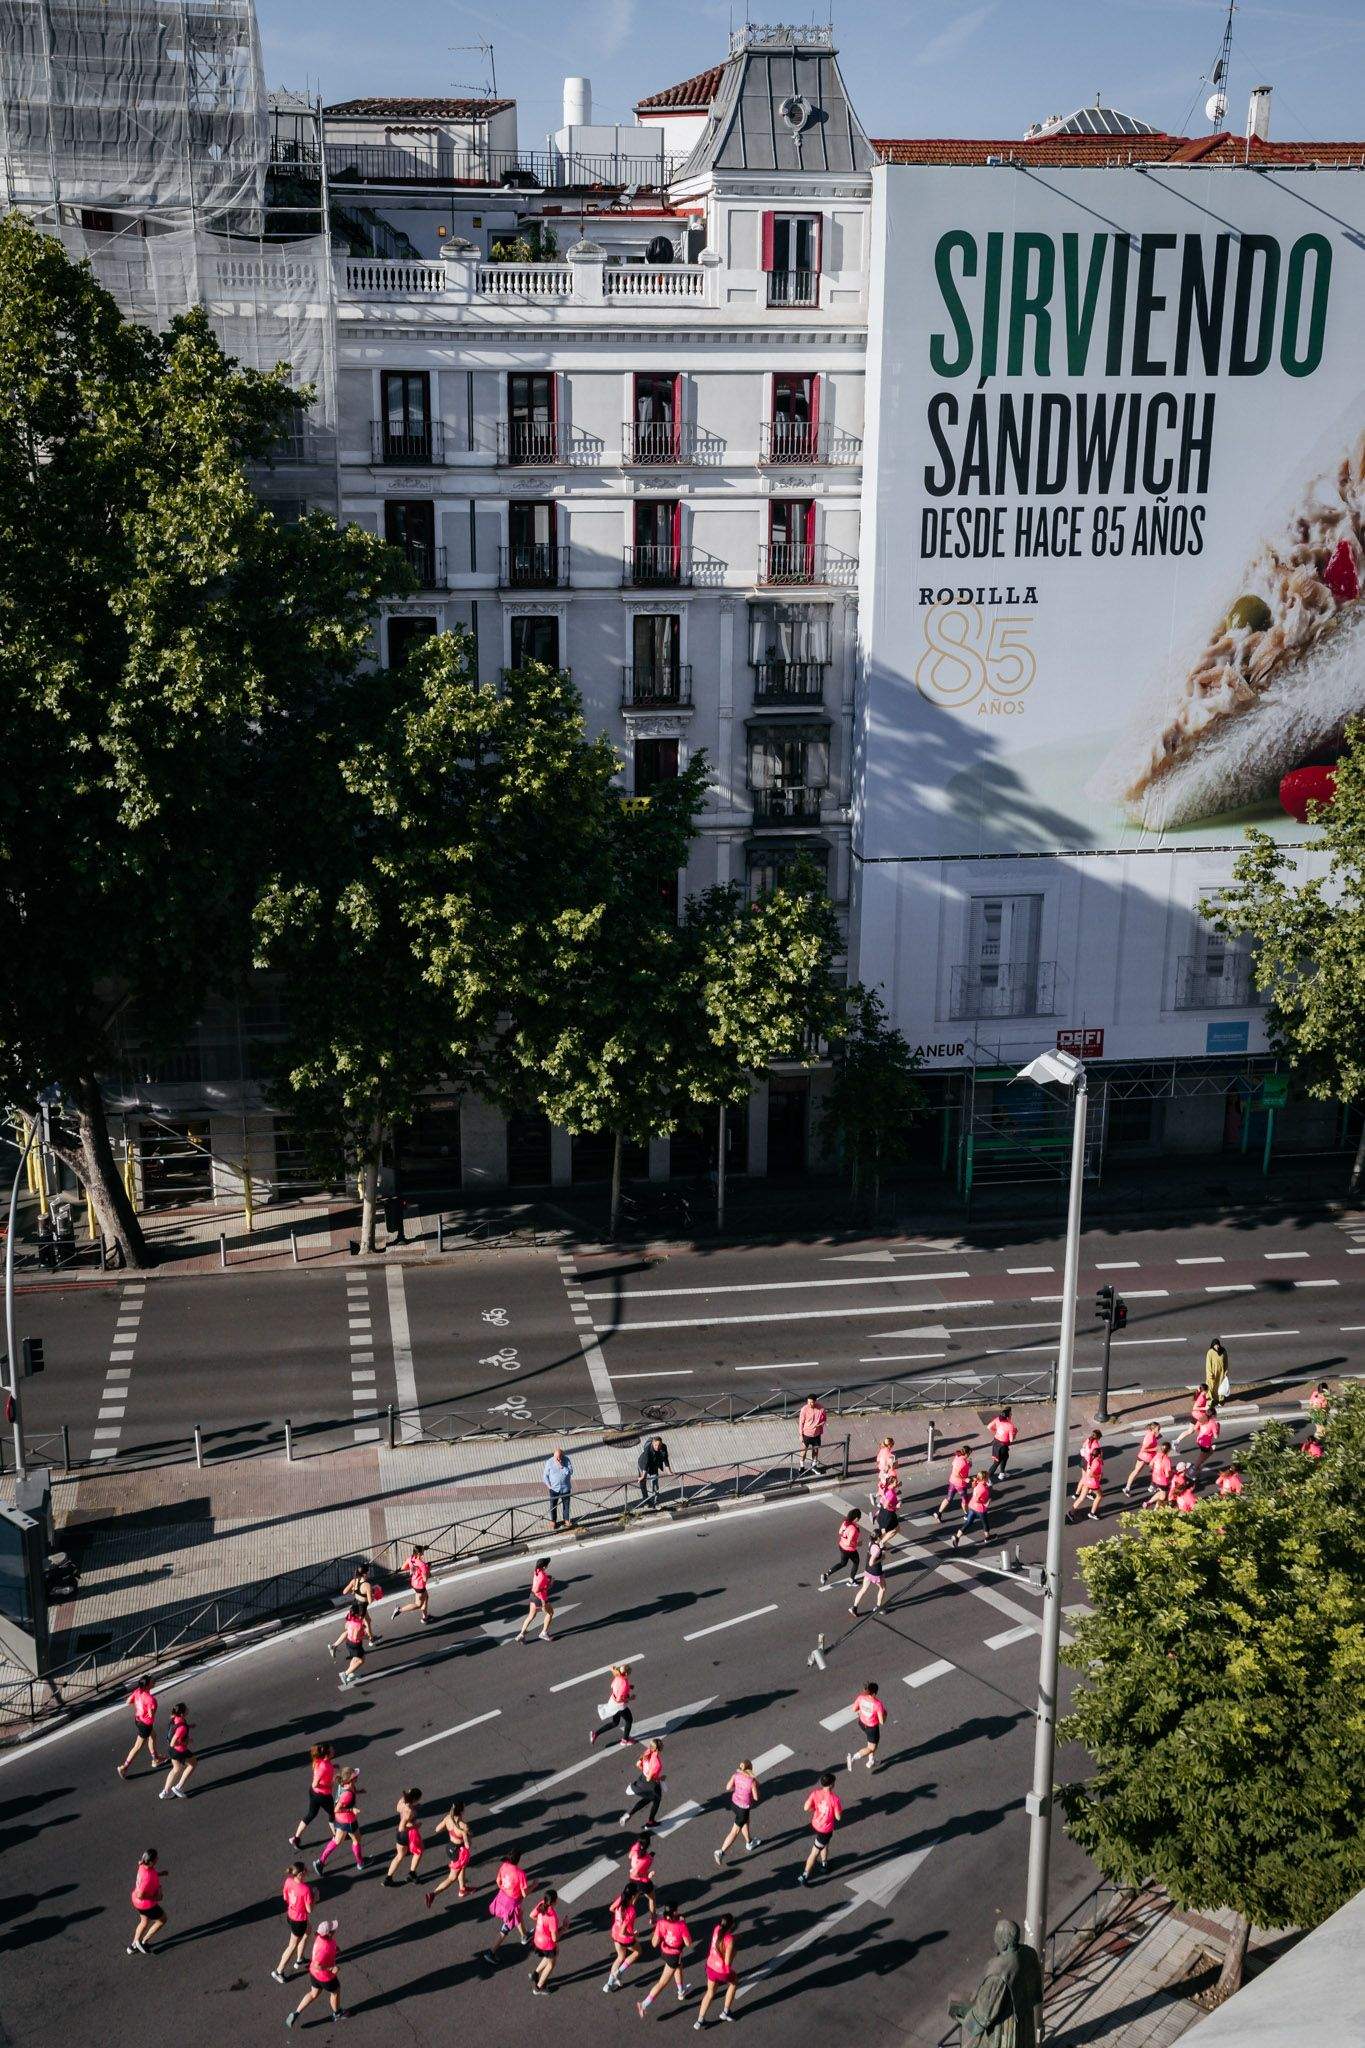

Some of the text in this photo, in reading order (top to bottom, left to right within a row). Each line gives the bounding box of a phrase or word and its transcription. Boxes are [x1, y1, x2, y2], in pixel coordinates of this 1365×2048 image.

[929, 230, 1332, 377] SIRVIENDO
[924, 377, 1216, 496] SÁNDWICH
[920, 496, 1206, 558] DESDE HACE 85 AÑOS
[919, 586, 1039, 606] RODILLA
[916, 597, 1037, 708] 85
[978, 699, 1025, 716] AÑOS
[912, 1044, 965, 1058] ANEUR
